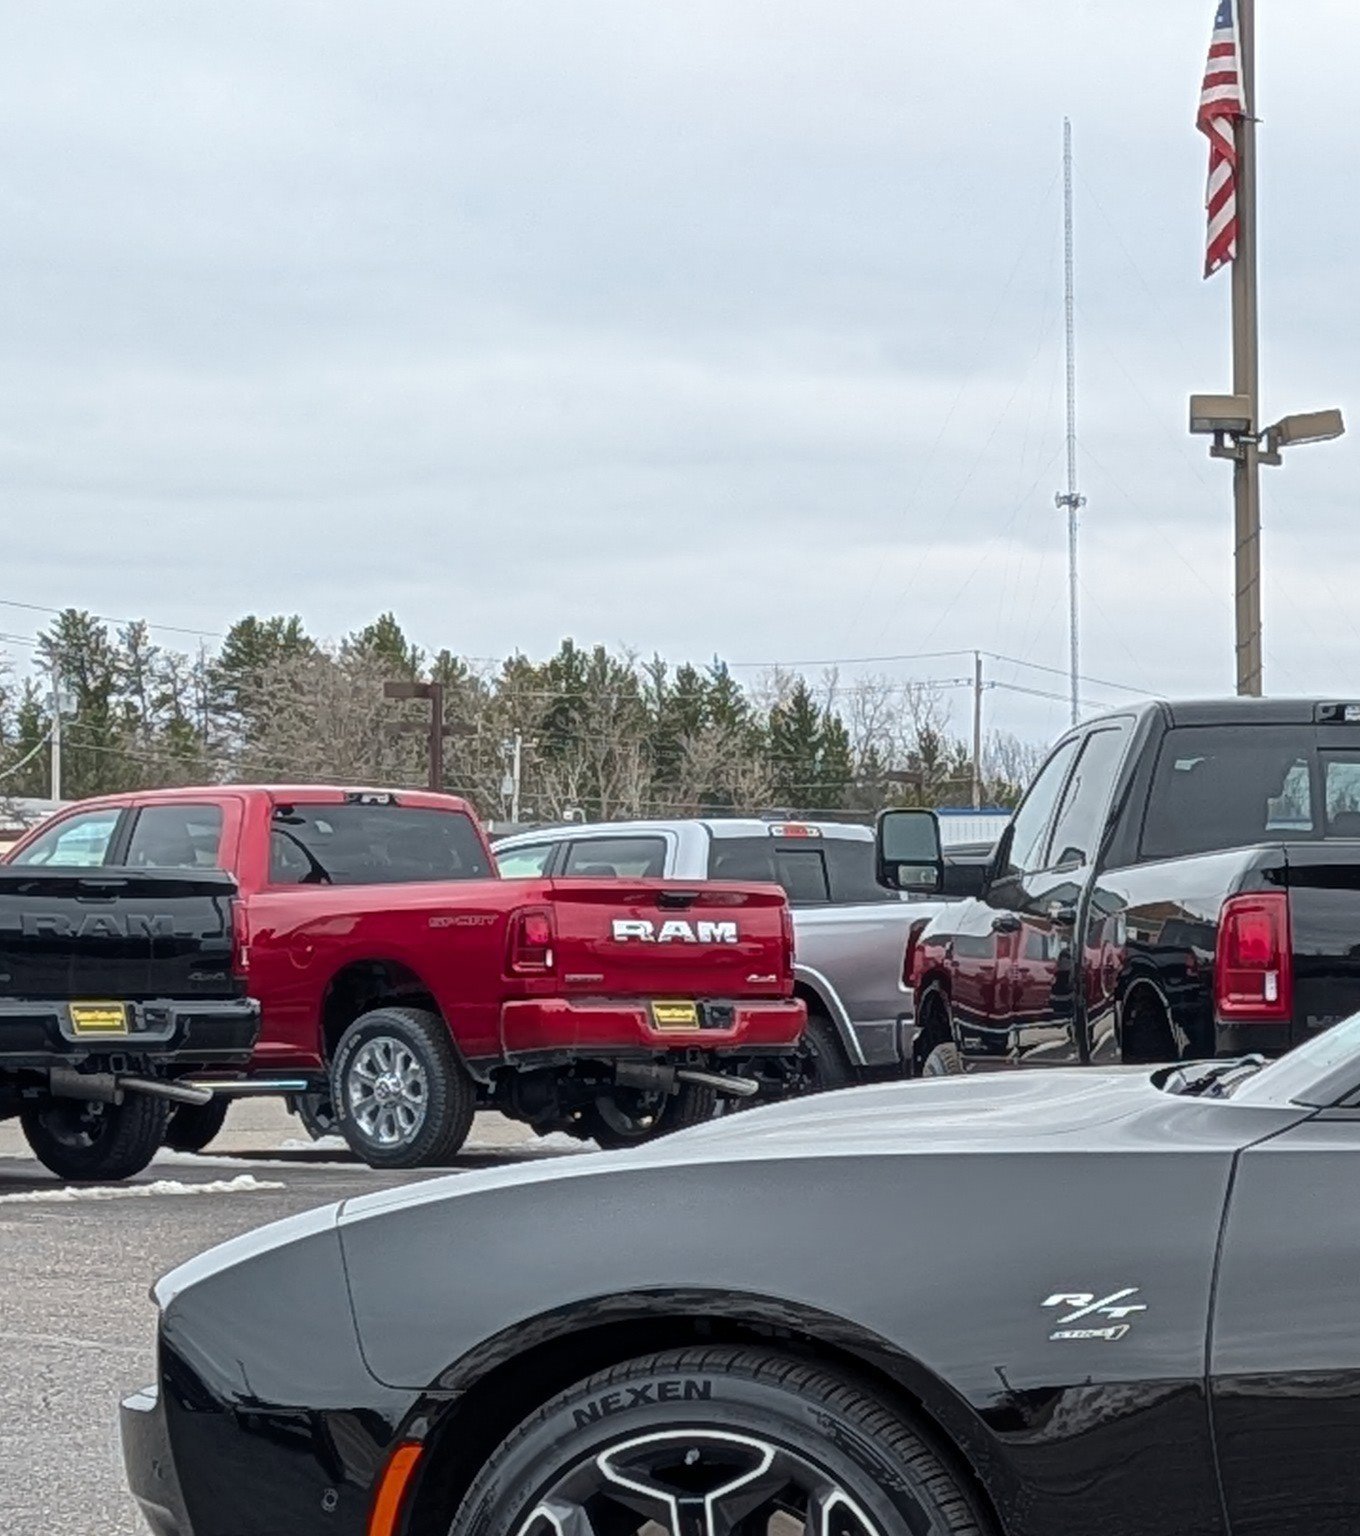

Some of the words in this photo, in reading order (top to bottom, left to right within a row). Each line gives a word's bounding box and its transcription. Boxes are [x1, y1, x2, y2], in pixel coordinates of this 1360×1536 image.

[19, 912, 175, 938] RAM
[611, 919, 739, 944] RAM
[1040, 1287, 1148, 1324] R/T
[572, 1379, 712, 1430] NEXEN
